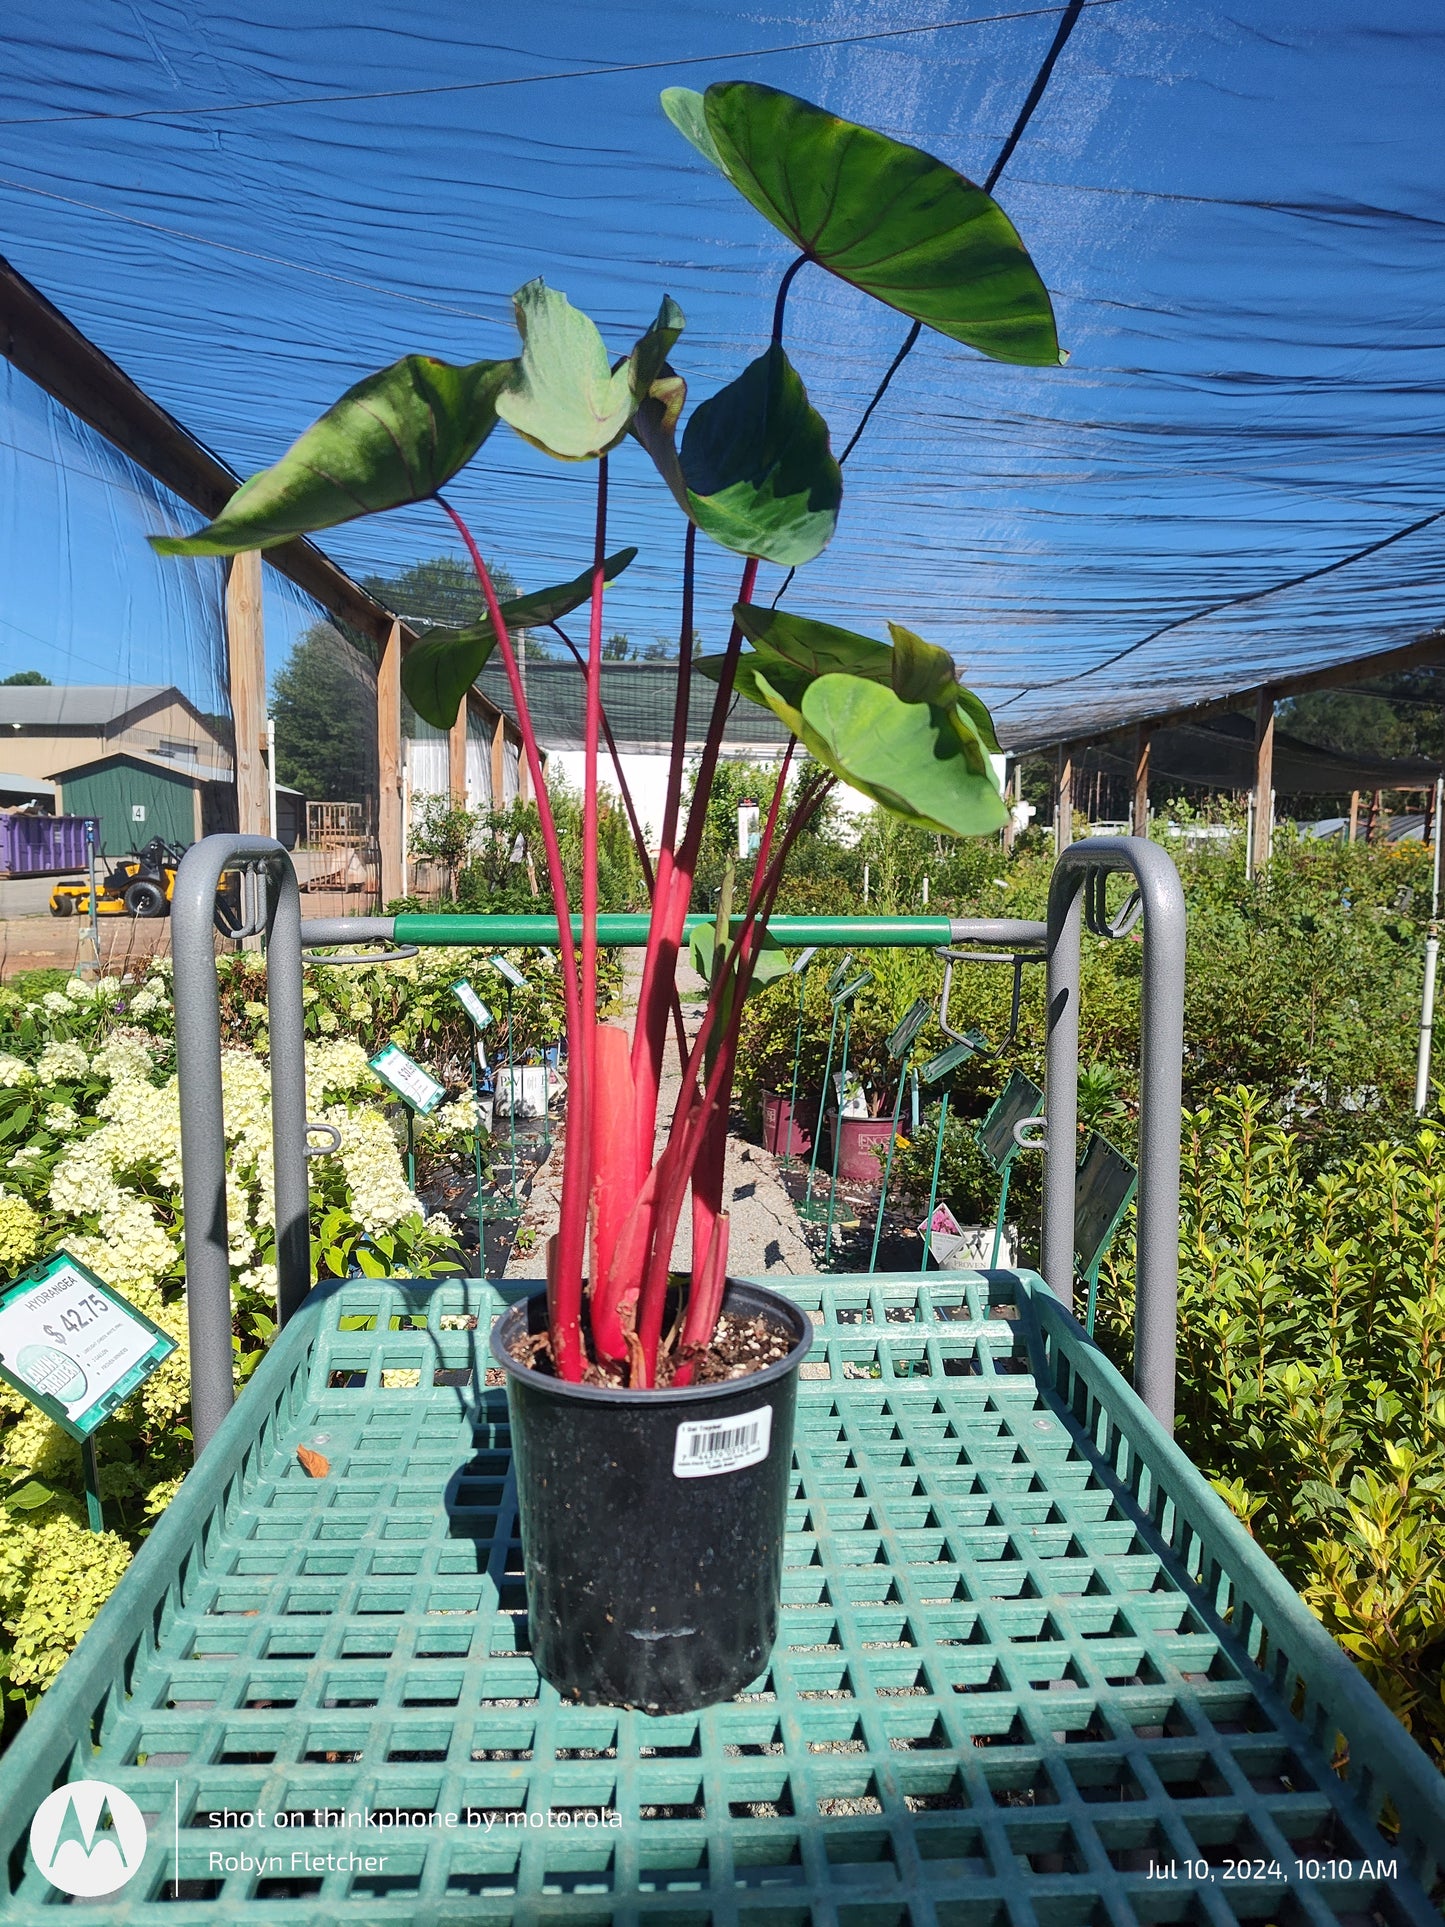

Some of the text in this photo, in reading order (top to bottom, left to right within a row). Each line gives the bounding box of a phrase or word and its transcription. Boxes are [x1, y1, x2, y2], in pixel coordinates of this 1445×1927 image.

[135, 807, 142, 819] 4
[25, 1275, 78, 1312] HYDRANGEA
[43, 1293, 109, 1346] $ 42.75
[22, 1354, 58, 1385] LAWN
[37, 1360, 81, 1396] GARDEN
